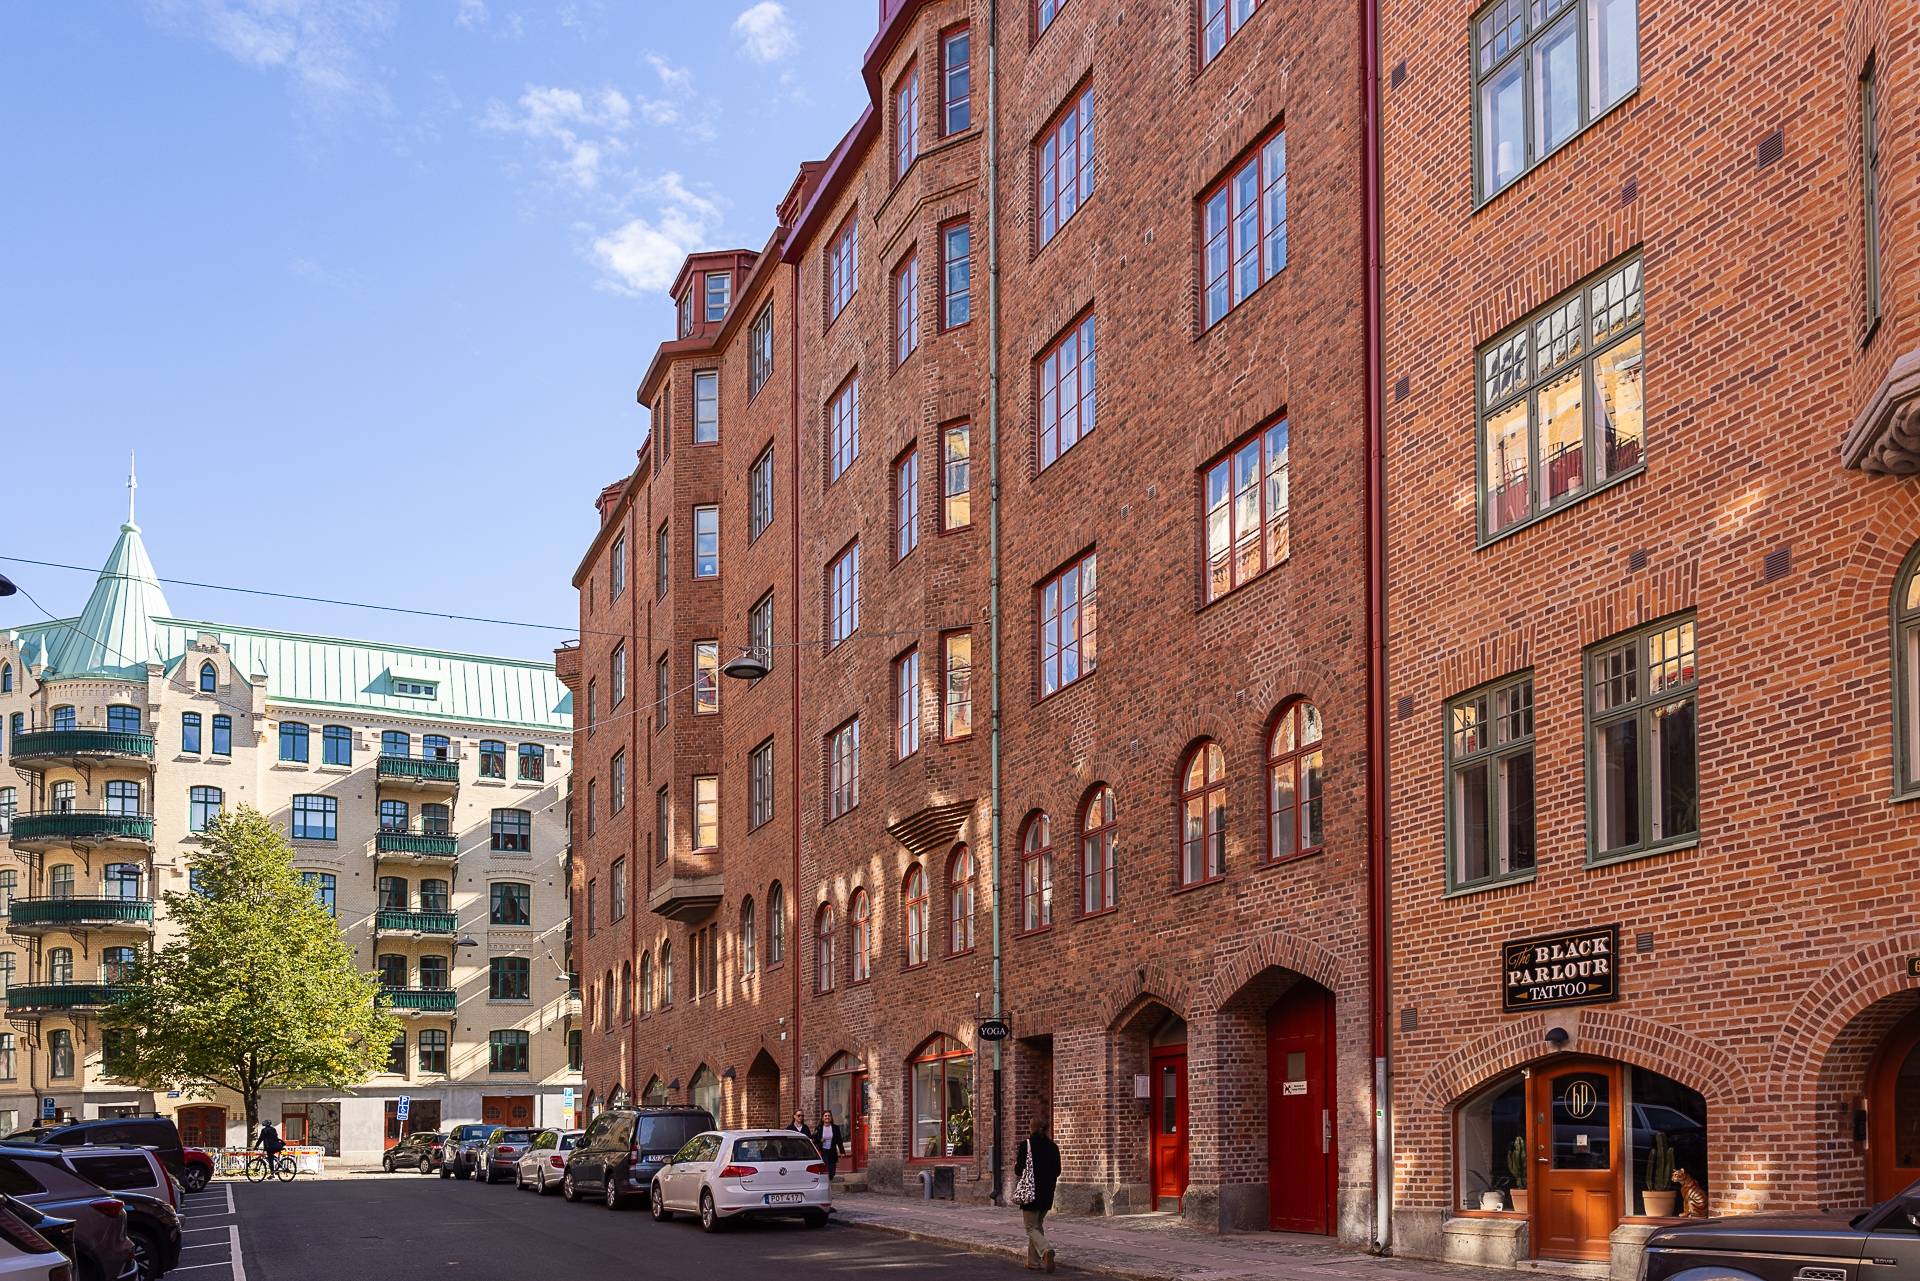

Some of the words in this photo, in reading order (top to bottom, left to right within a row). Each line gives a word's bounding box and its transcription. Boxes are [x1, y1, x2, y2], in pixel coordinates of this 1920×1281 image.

[1508, 945, 1535, 969] The
[1535, 937, 1609, 962] BLACK
[1508, 959, 1609, 987] PARLOUR
[1529, 982, 1587, 1001] TATTOO
[981, 1027, 1006, 1036] YOGA
[46, 1098, 53, 1107] P
[402, 1096, 408, 1105] P
